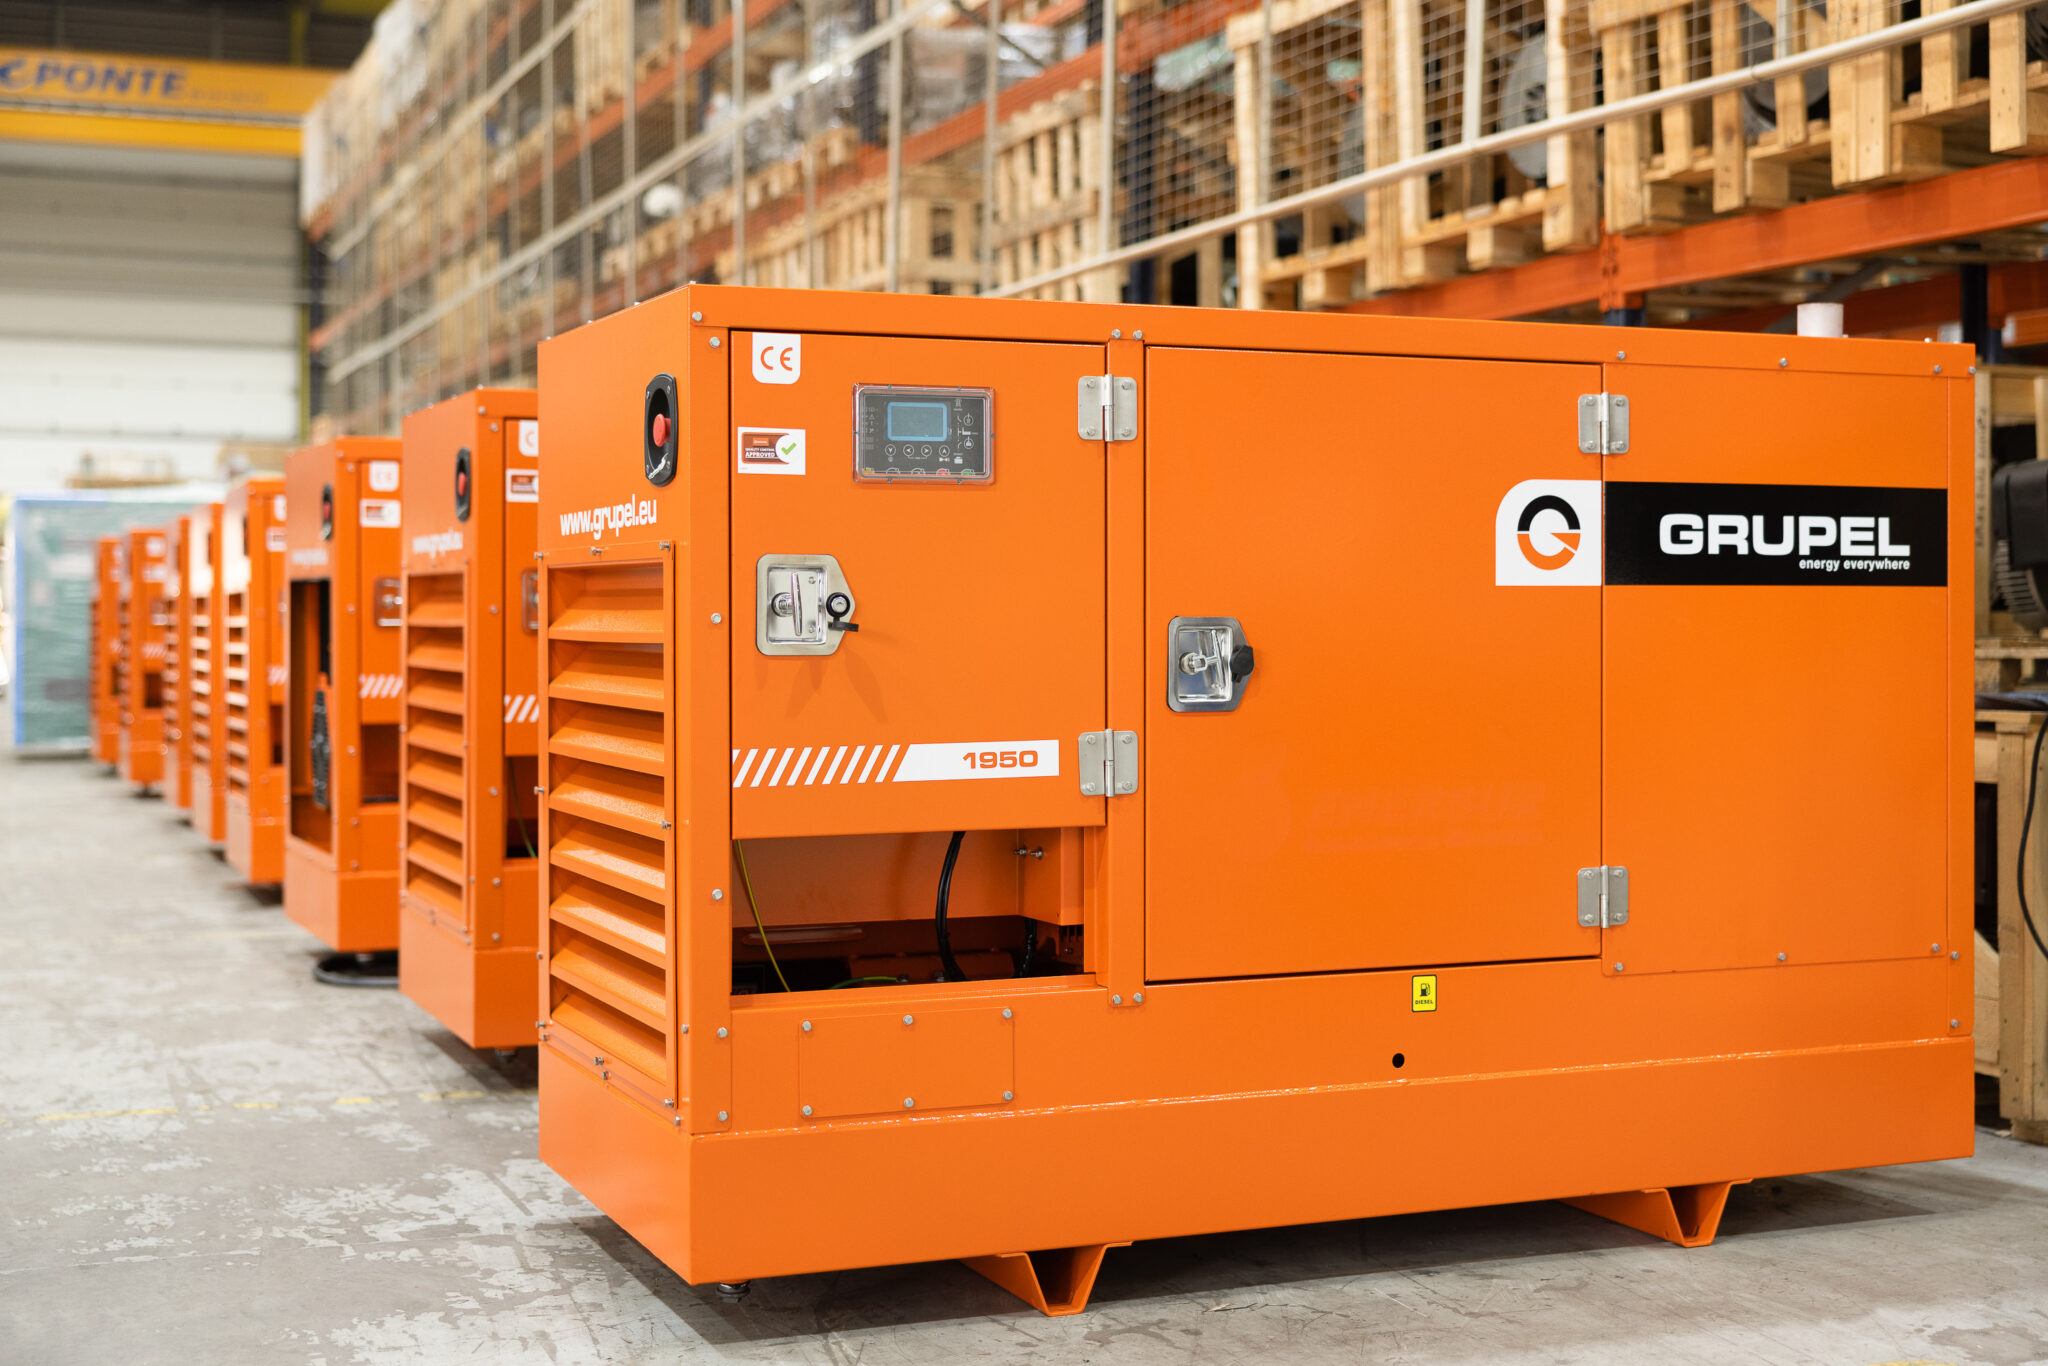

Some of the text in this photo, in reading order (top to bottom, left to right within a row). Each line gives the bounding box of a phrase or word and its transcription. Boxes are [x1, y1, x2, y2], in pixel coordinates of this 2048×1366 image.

[760, 346, 793, 371] CE
[560, 493, 657, 540] www.grupel.eu
[1659, 513, 1910, 556] GRUPEL
[1799, 558, 1911, 572] energy everywhere
[963, 750, 1039, 769] 1950
